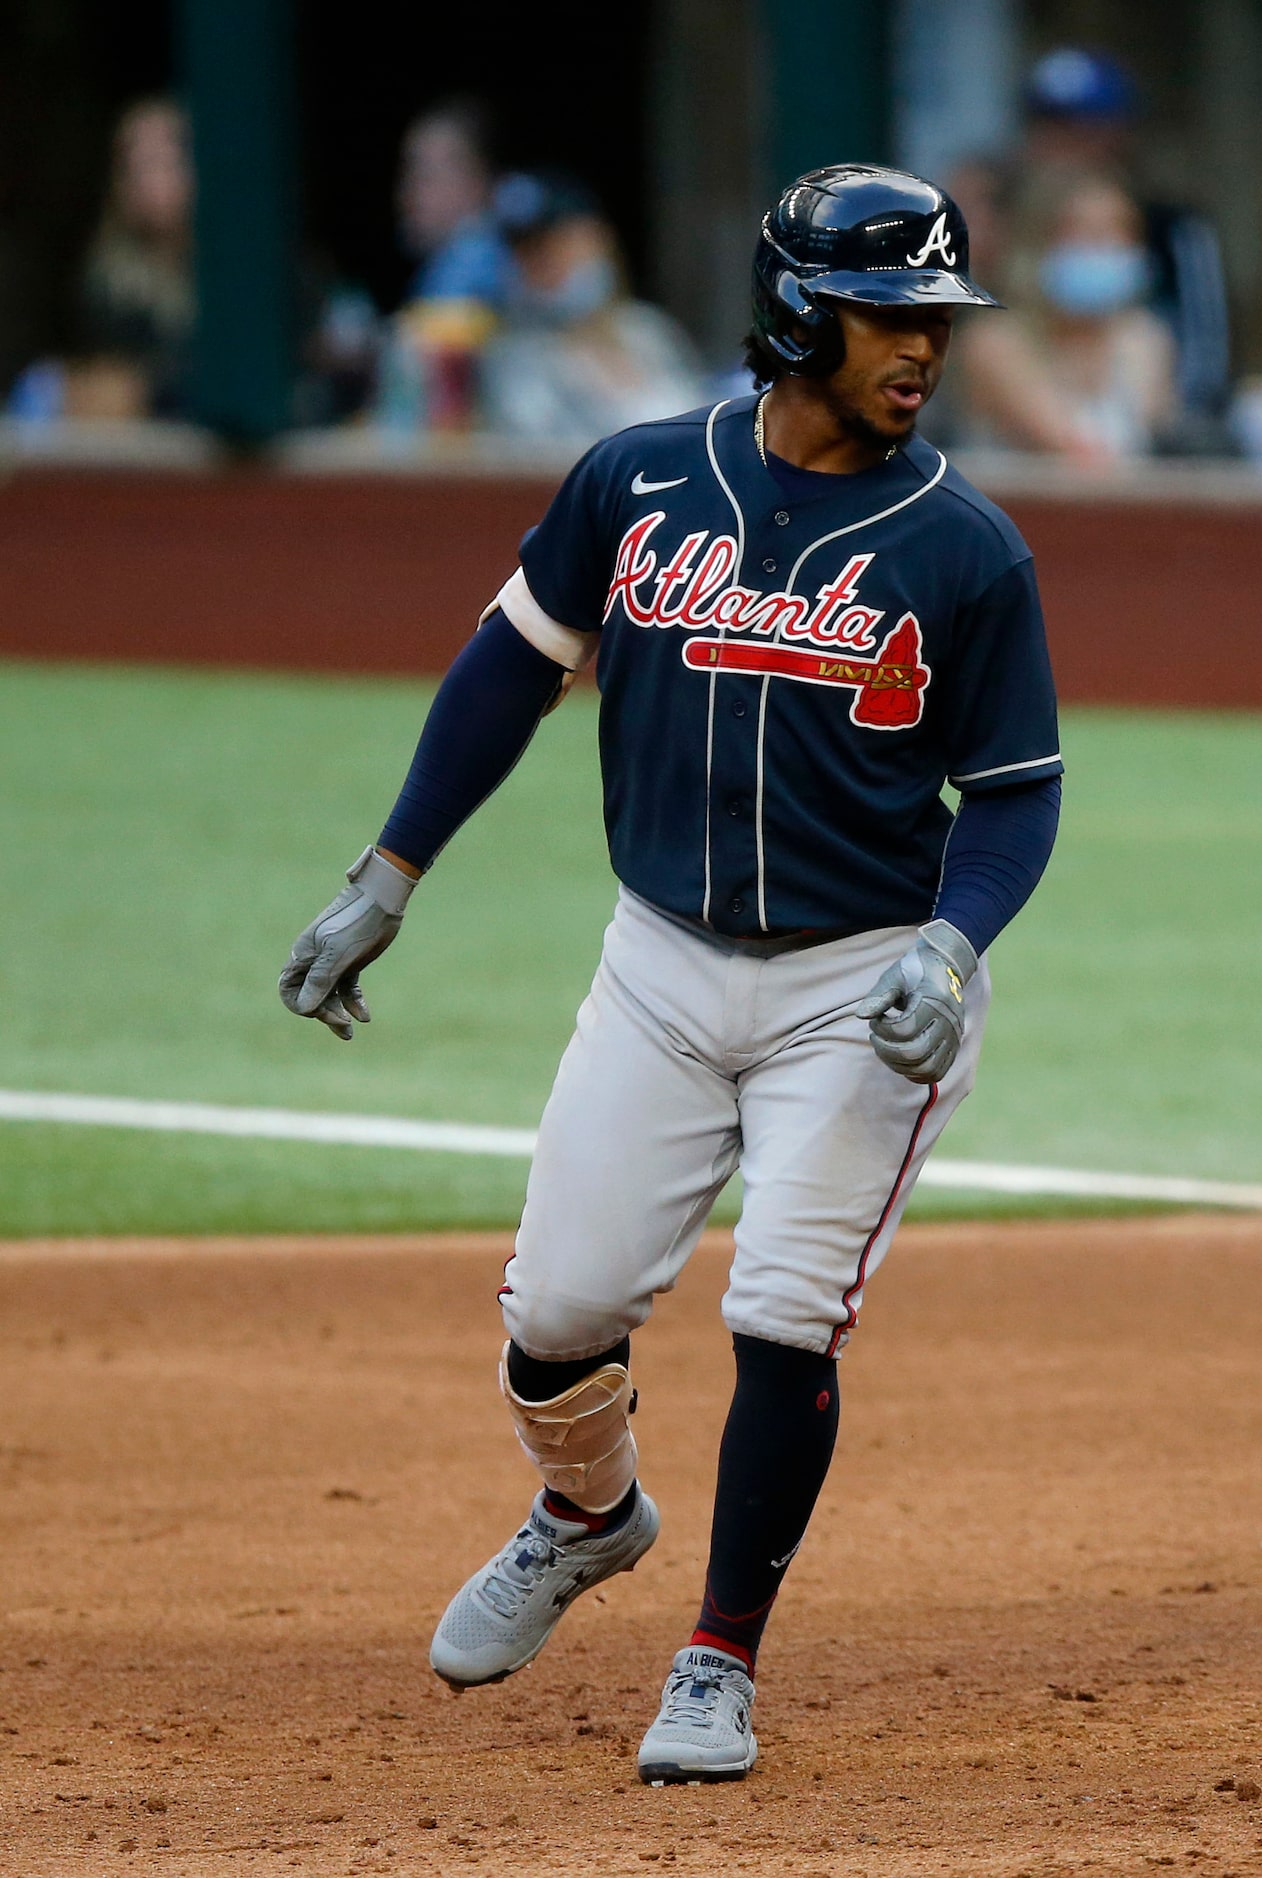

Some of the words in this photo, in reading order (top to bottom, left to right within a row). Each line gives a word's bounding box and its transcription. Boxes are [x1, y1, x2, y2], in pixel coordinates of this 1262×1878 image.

[906, 212, 957, 267] A
[602, 510, 886, 651] Atlanta
[686, 1652, 725, 1668] ALBIES
